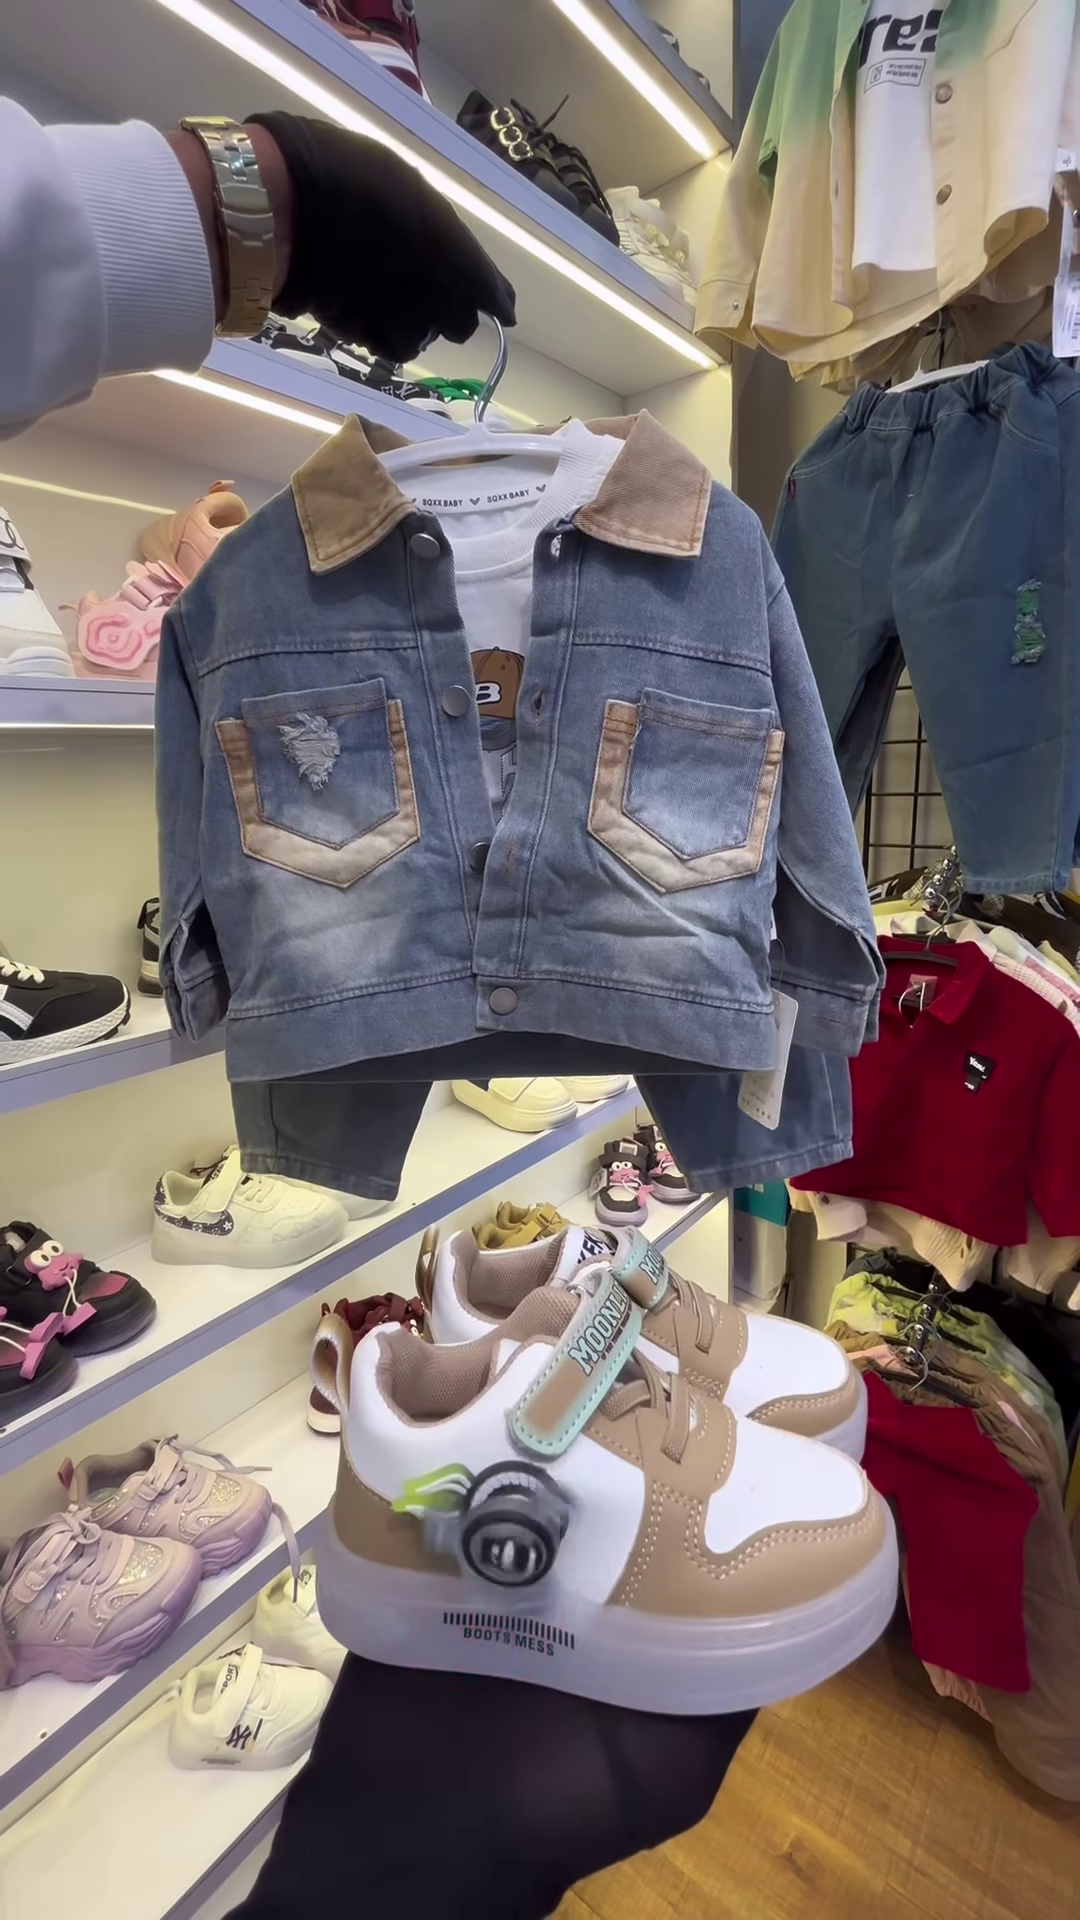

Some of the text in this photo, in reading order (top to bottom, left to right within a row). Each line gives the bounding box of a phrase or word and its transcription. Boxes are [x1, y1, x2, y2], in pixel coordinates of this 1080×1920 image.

[443, 499, 463, 507] BABY
[508, 489, 530, 500] BABY
[475, 681, 502, 705] B
[463, 1627, 554, 1657] BOOTS MESS
